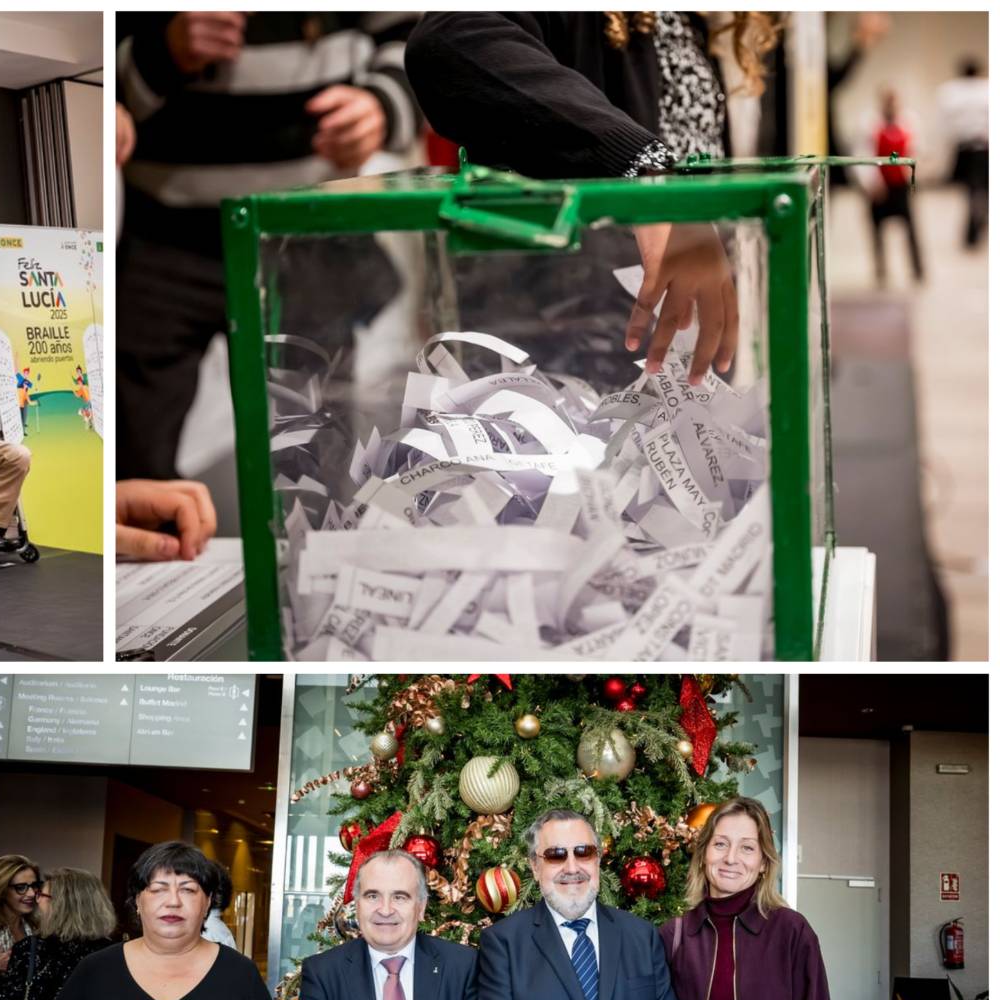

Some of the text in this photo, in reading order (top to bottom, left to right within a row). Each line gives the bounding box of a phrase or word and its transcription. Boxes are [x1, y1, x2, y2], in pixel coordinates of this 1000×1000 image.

[20, 271, 64, 287] SANTA
[21, 288, 67, 308] LUCÍA
[51, 310, 69, 320] 2025
[26, 326, 70, 340] BRAILLE
[28, 340, 73, 355] 200 años
[656, 369, 679, 408] ABLO
[658, 432, 685, 478] PLAZA
